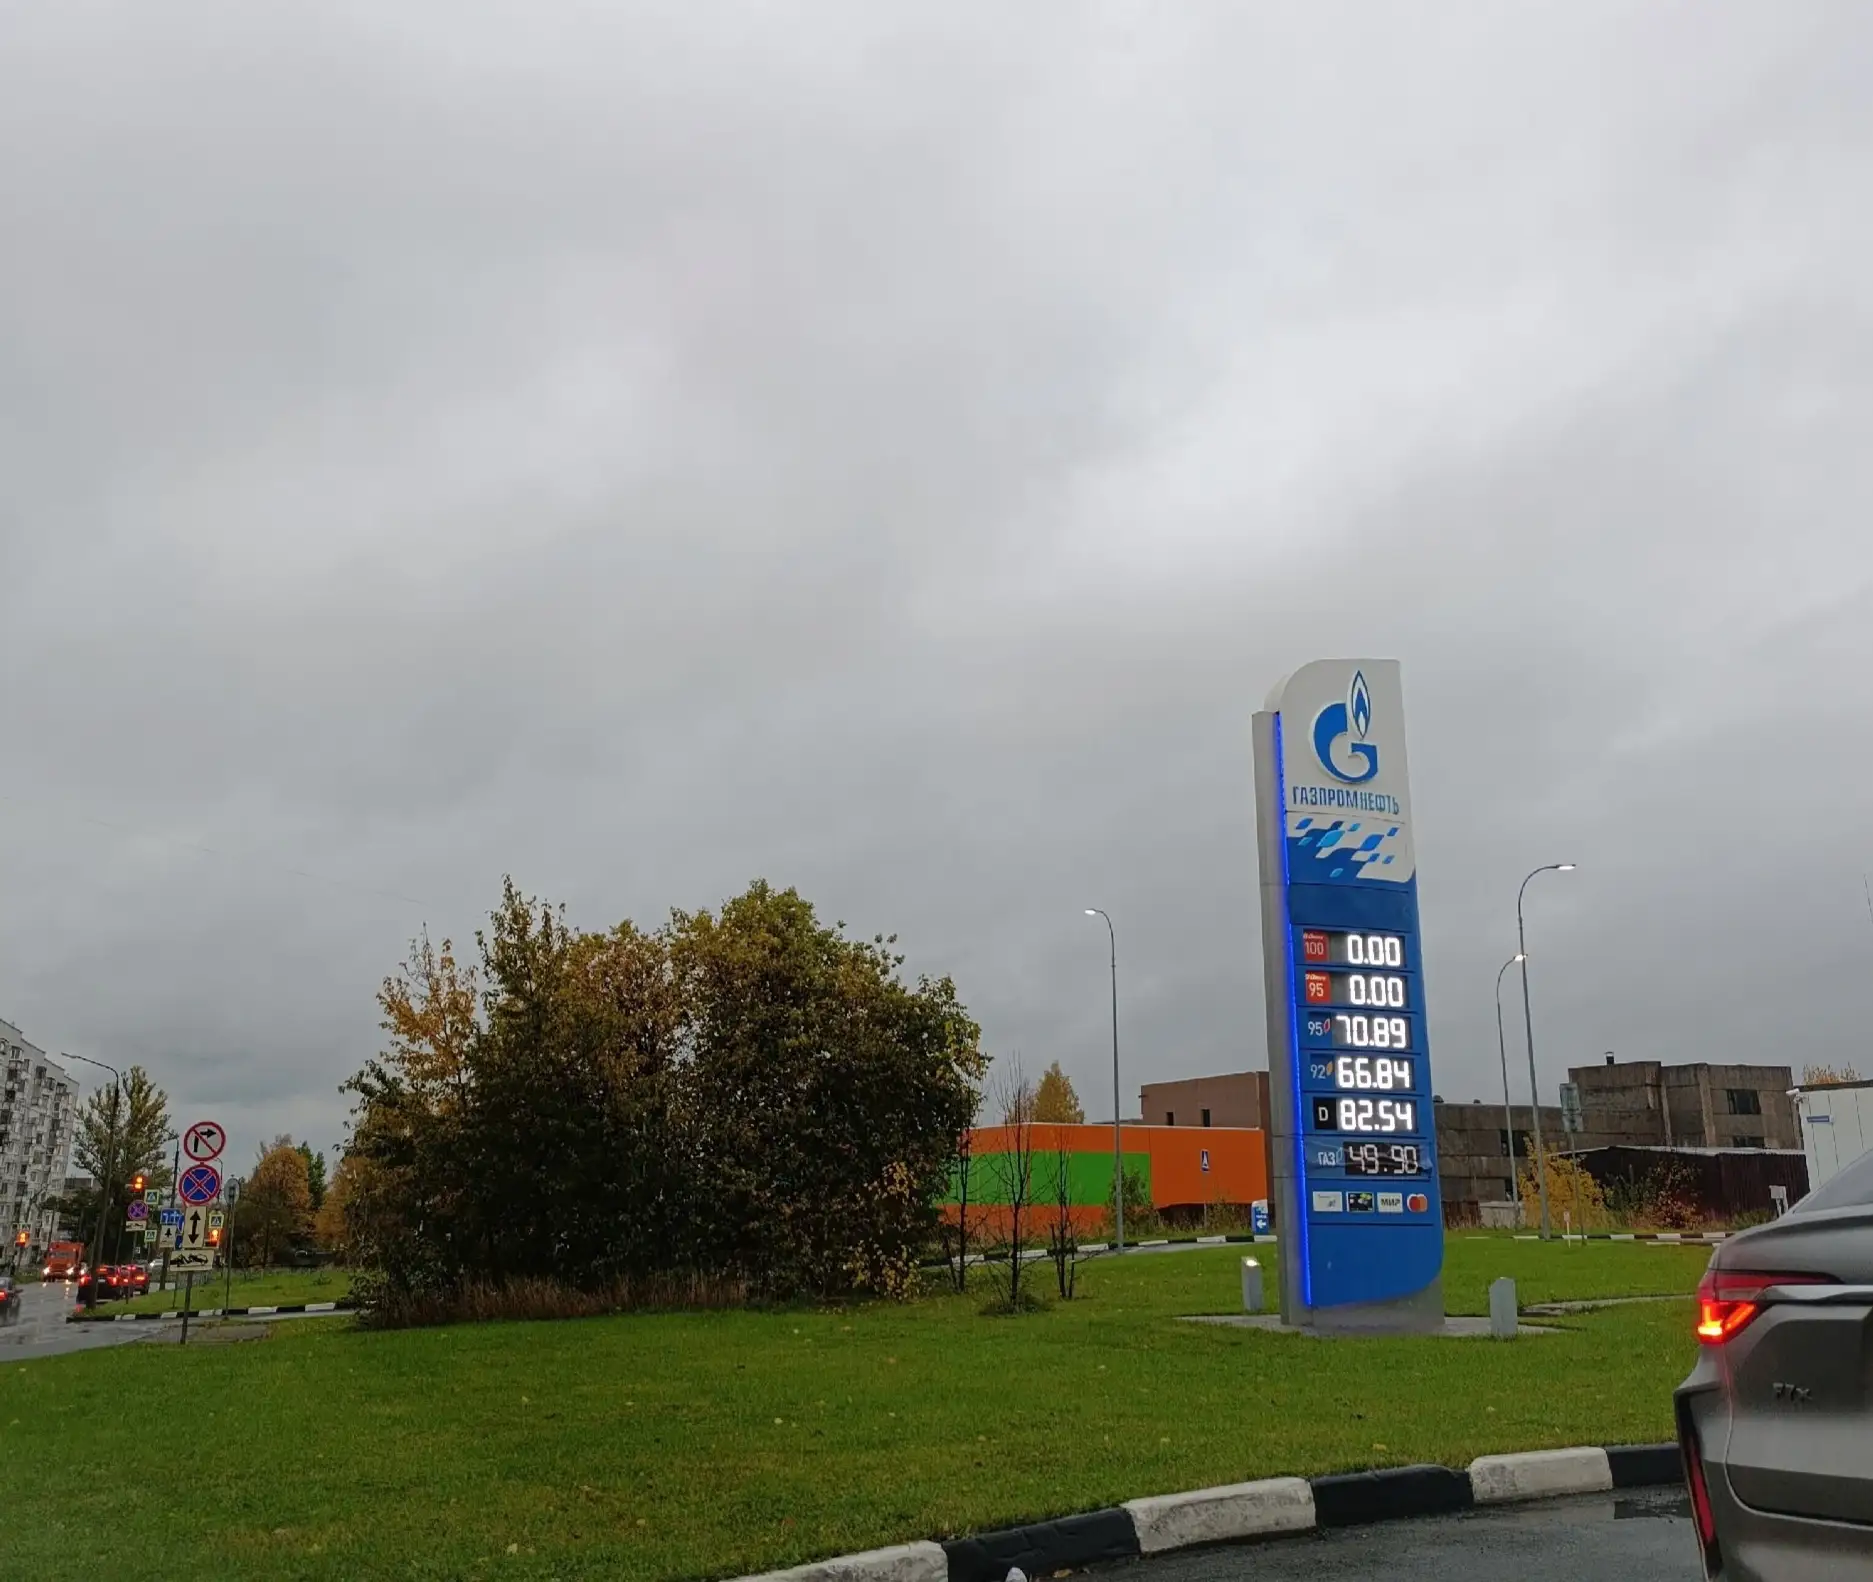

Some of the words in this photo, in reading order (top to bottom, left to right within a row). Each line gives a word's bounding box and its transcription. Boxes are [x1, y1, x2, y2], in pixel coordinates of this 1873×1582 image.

[1293, 786, 1400, 815] ГАЗПРОМНЕФТЬ
[1305, 941, 1324, 955] 100
[1347, 935, 1401, 966] 0.00
[1309, 982, 1324, 997] 95
[1350, 975, 1404, 1007] 0.00
[1308, 1021, 1323, 1036] 95
[1336, 1015, 1406, 1048] 70.89
[1310, 1064, 1326, 1079] 92
[1337, 1057, 1410, 1089] 66.84
[1318, 1107, 1329, 1121] D
[1340, 1100, 1412, 1131] 82.54
[1318, 1152, 1336, 1166] ГАЗ
[1349, 1144, 1418, 1174] 49.90
